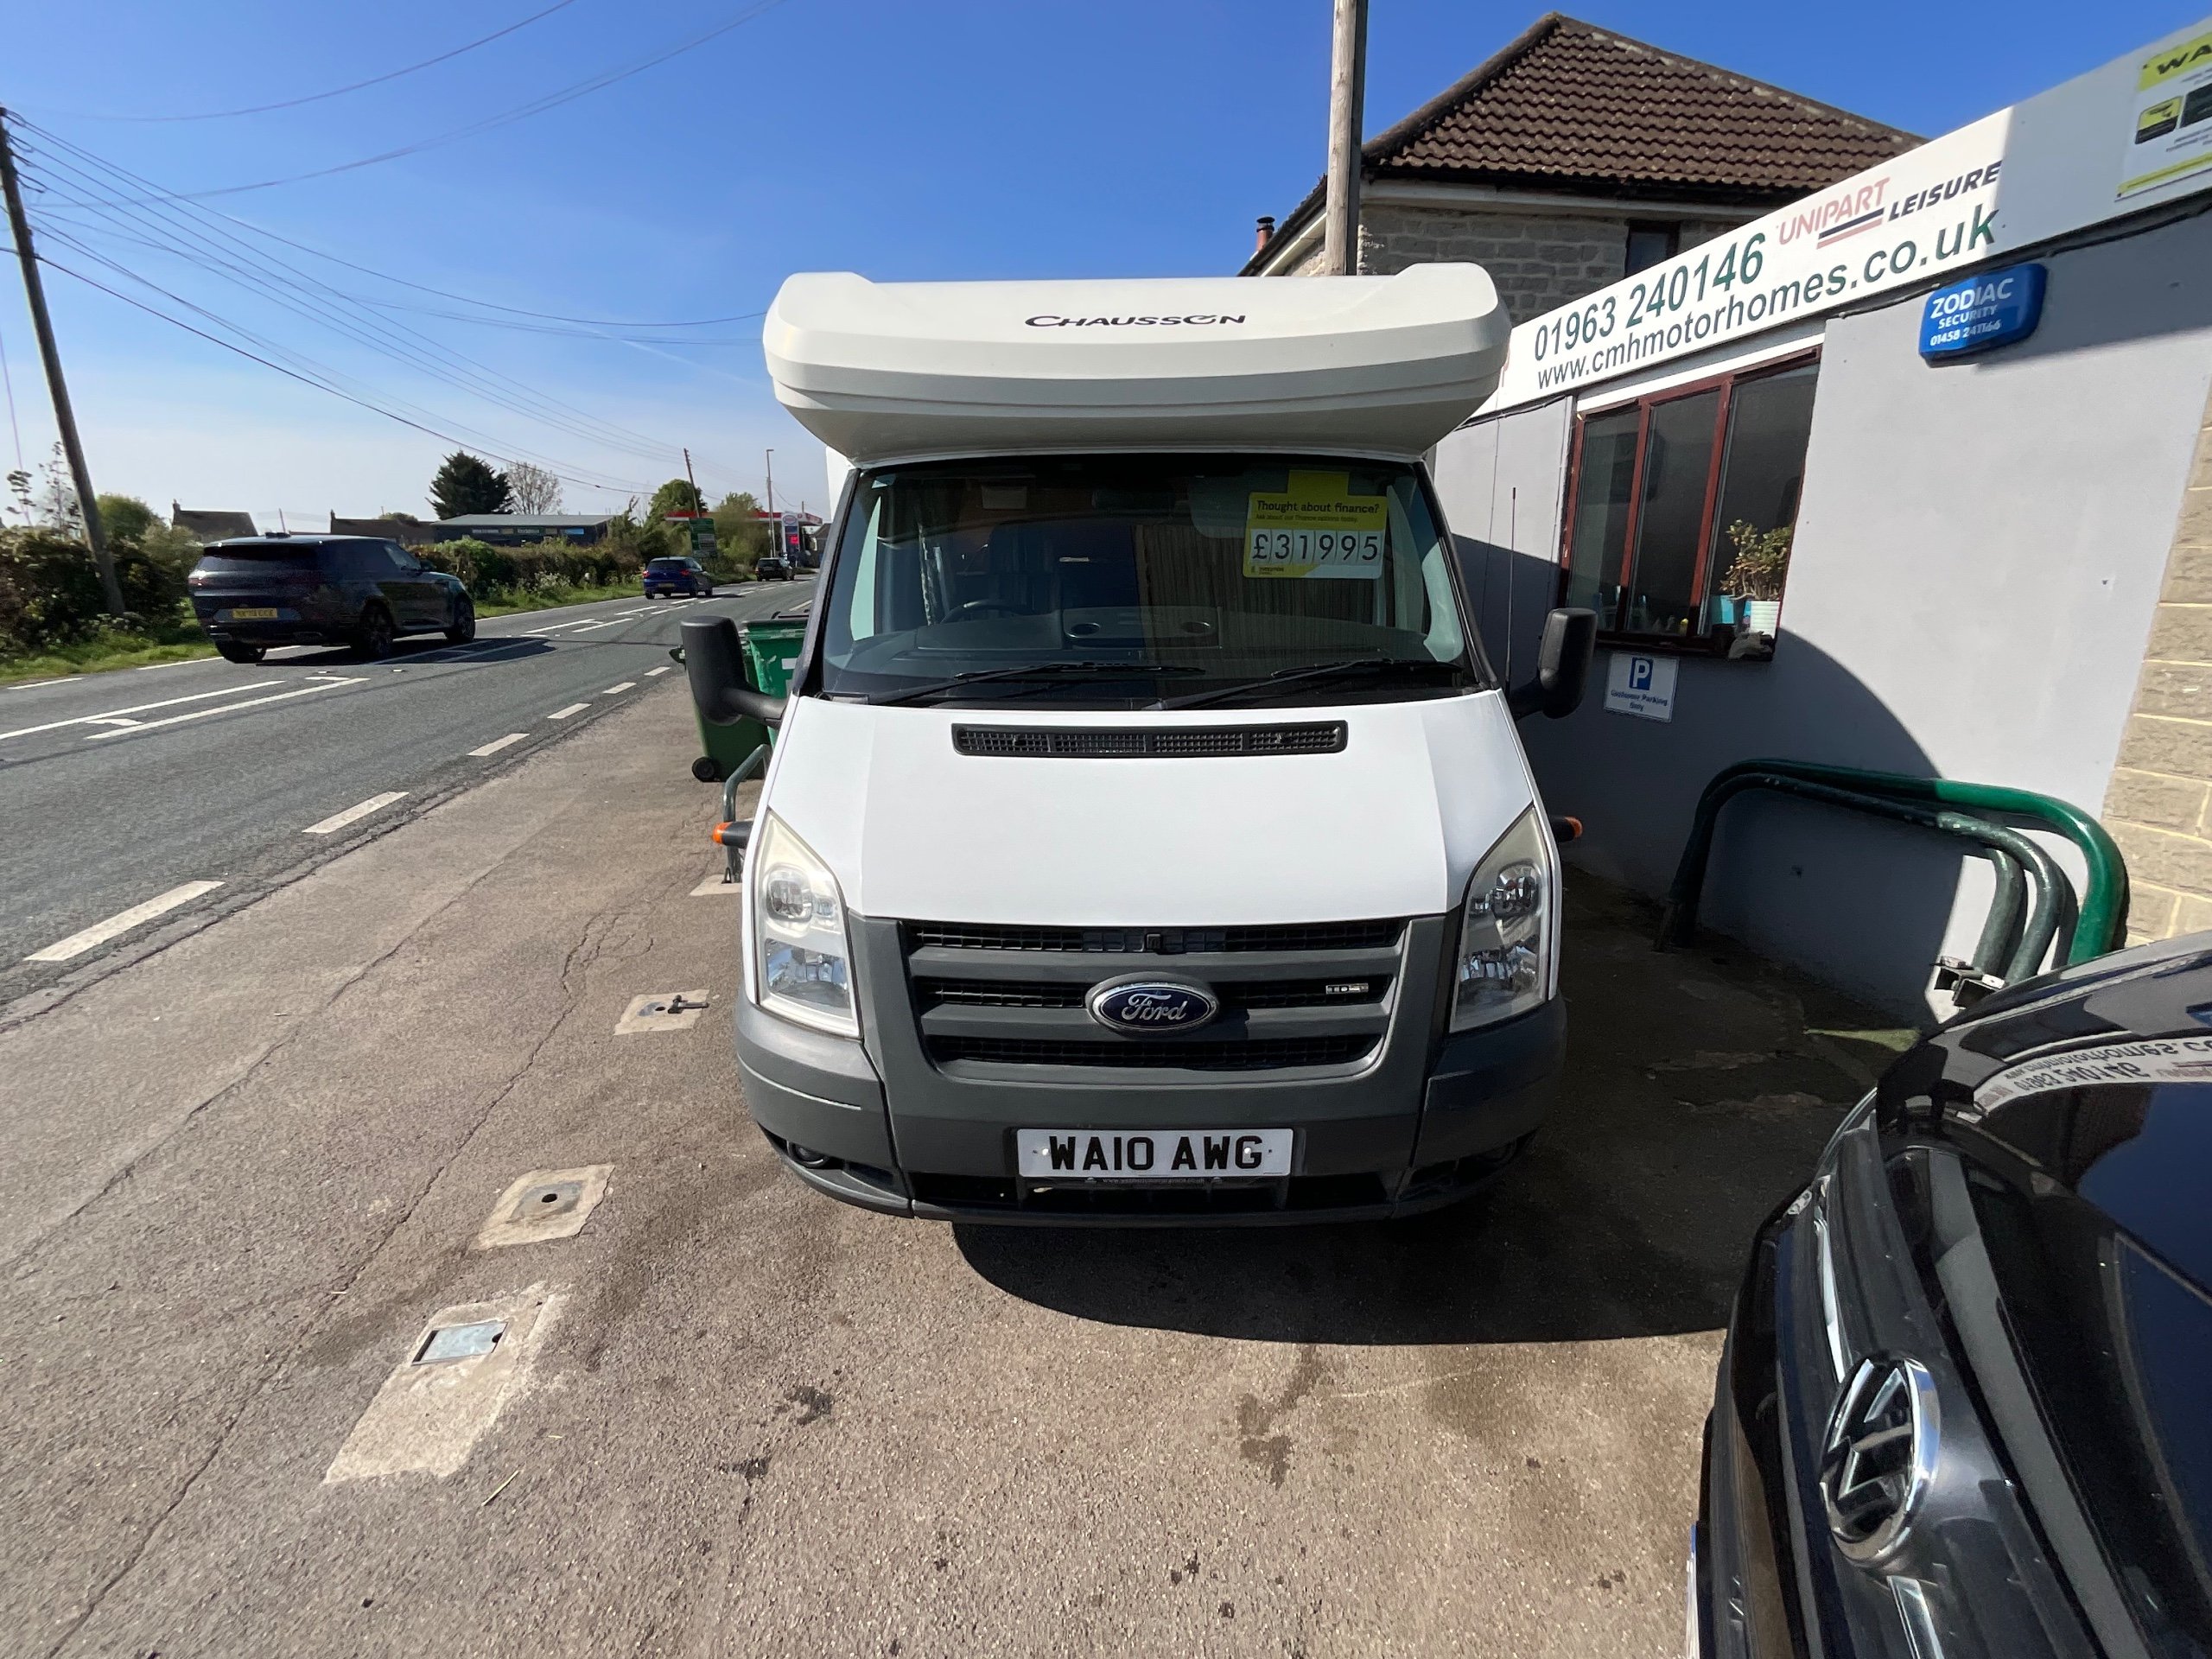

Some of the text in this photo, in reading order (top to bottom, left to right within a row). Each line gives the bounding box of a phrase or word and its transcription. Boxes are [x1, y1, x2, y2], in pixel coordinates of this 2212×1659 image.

[1888, 160, 2003, 221] LEISURE
[1778, 176, 1891, 246] UNIPART
[1535, 232, 1766, 361] 01963 240146
[1538, 203, 1999, 390] www.cmhmotorhomes.co.uk
[1930, 277, 2014, 319] ZODIAC
[1025, 315, 1246, 327] CHAUSSON
[1937, 303, 1999, 329] SECURITY
[1929, 329, 1961, 346] 01458
[1256, 500, 1380, 514] Thought about finance?
[1253, 533, 1378, 561] £31995
[1632, 659, 1650, 688] P
[1121, 993, 1189, 1021] Ford
[1048, 1135, 1263, 1171] WA10 AWG
